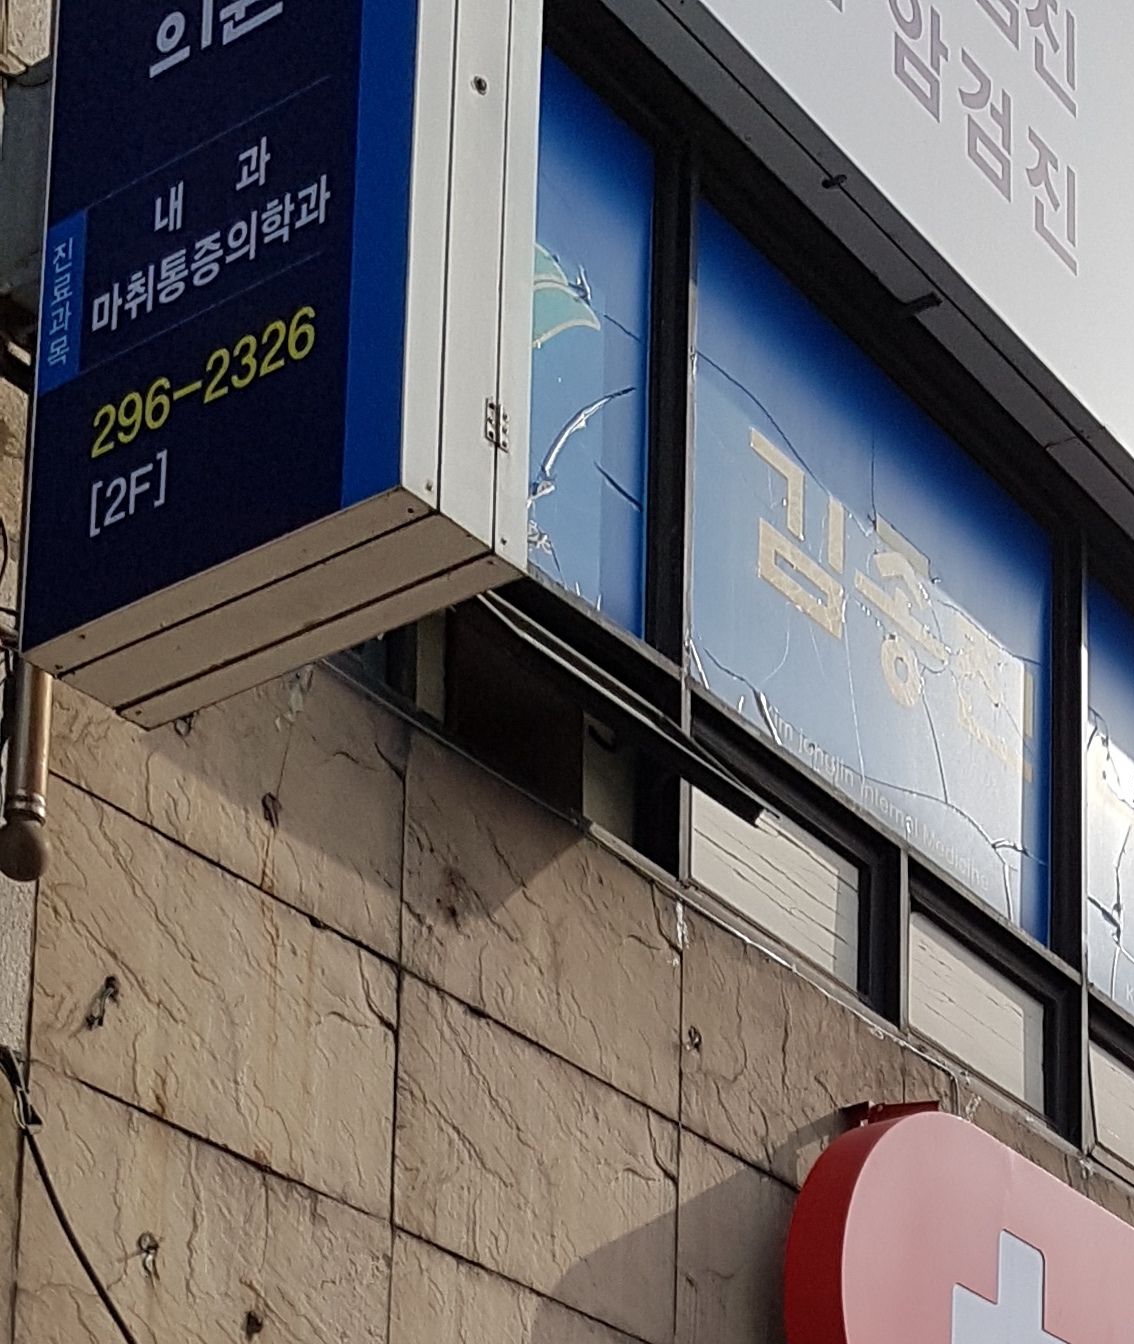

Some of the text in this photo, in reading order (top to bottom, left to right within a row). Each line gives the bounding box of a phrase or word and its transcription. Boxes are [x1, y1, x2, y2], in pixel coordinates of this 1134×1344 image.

[889, 0, 1078, 276] 암검진
[47, 237, 74, 367] 진료과목
[92, 174, 331, 333] 마취통증의학과
[91, 305, 316, 459] 296-2326
[90, 449, 168, 538] [2F]
